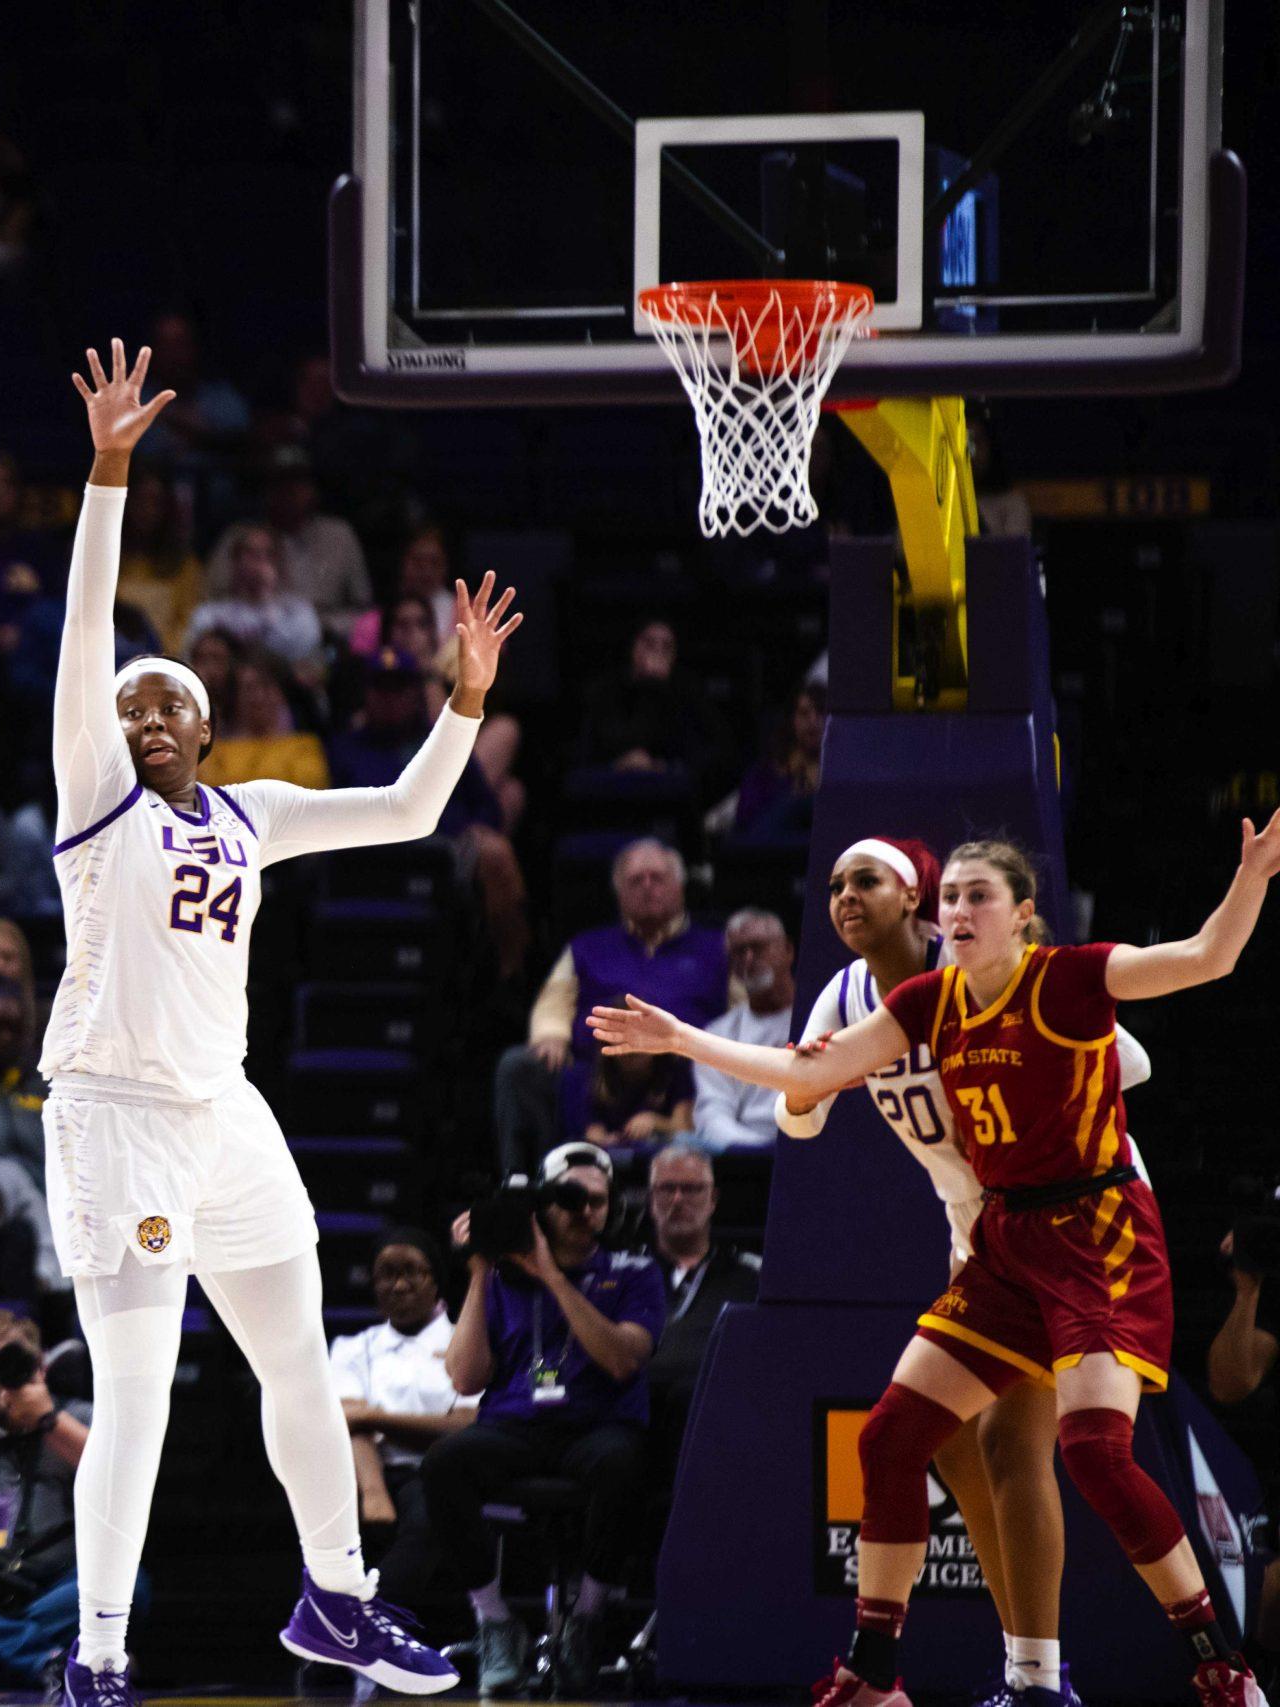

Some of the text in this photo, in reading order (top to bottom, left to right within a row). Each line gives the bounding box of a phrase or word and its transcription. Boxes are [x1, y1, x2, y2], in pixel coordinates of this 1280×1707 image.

[162, 826, 247, 867] LSU
[171, 865, 241, 943] 24
[967, 1048, 1023, 1067] STATE
[877, 1085, 946, 1145] 20
[955, 1083, 1018, 1146] 31
